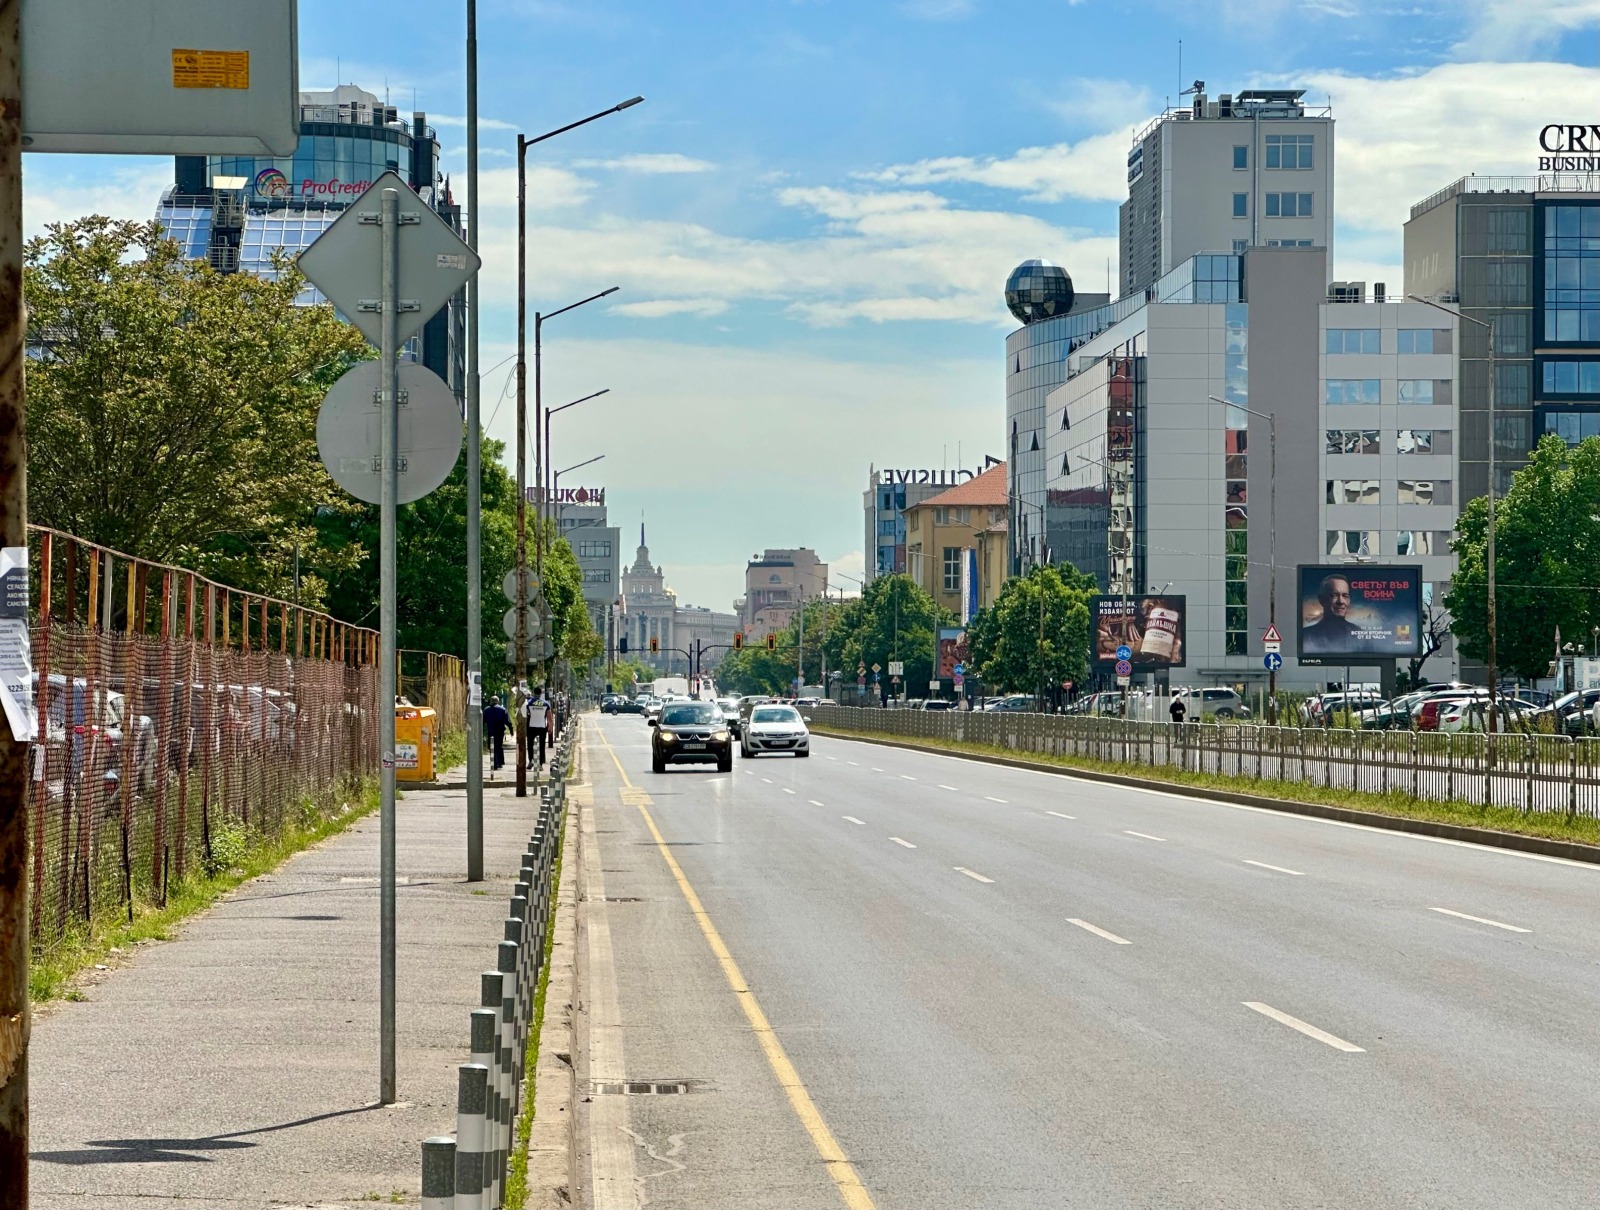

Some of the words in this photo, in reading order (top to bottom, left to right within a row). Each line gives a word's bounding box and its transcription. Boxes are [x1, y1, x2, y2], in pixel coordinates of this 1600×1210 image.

[1351, 581, 1388, 589] СВЕТЪТ
[1390, 581, 1410, 589] ВЪВ
[1363, 589, 1396, 598] ВОЙНА
